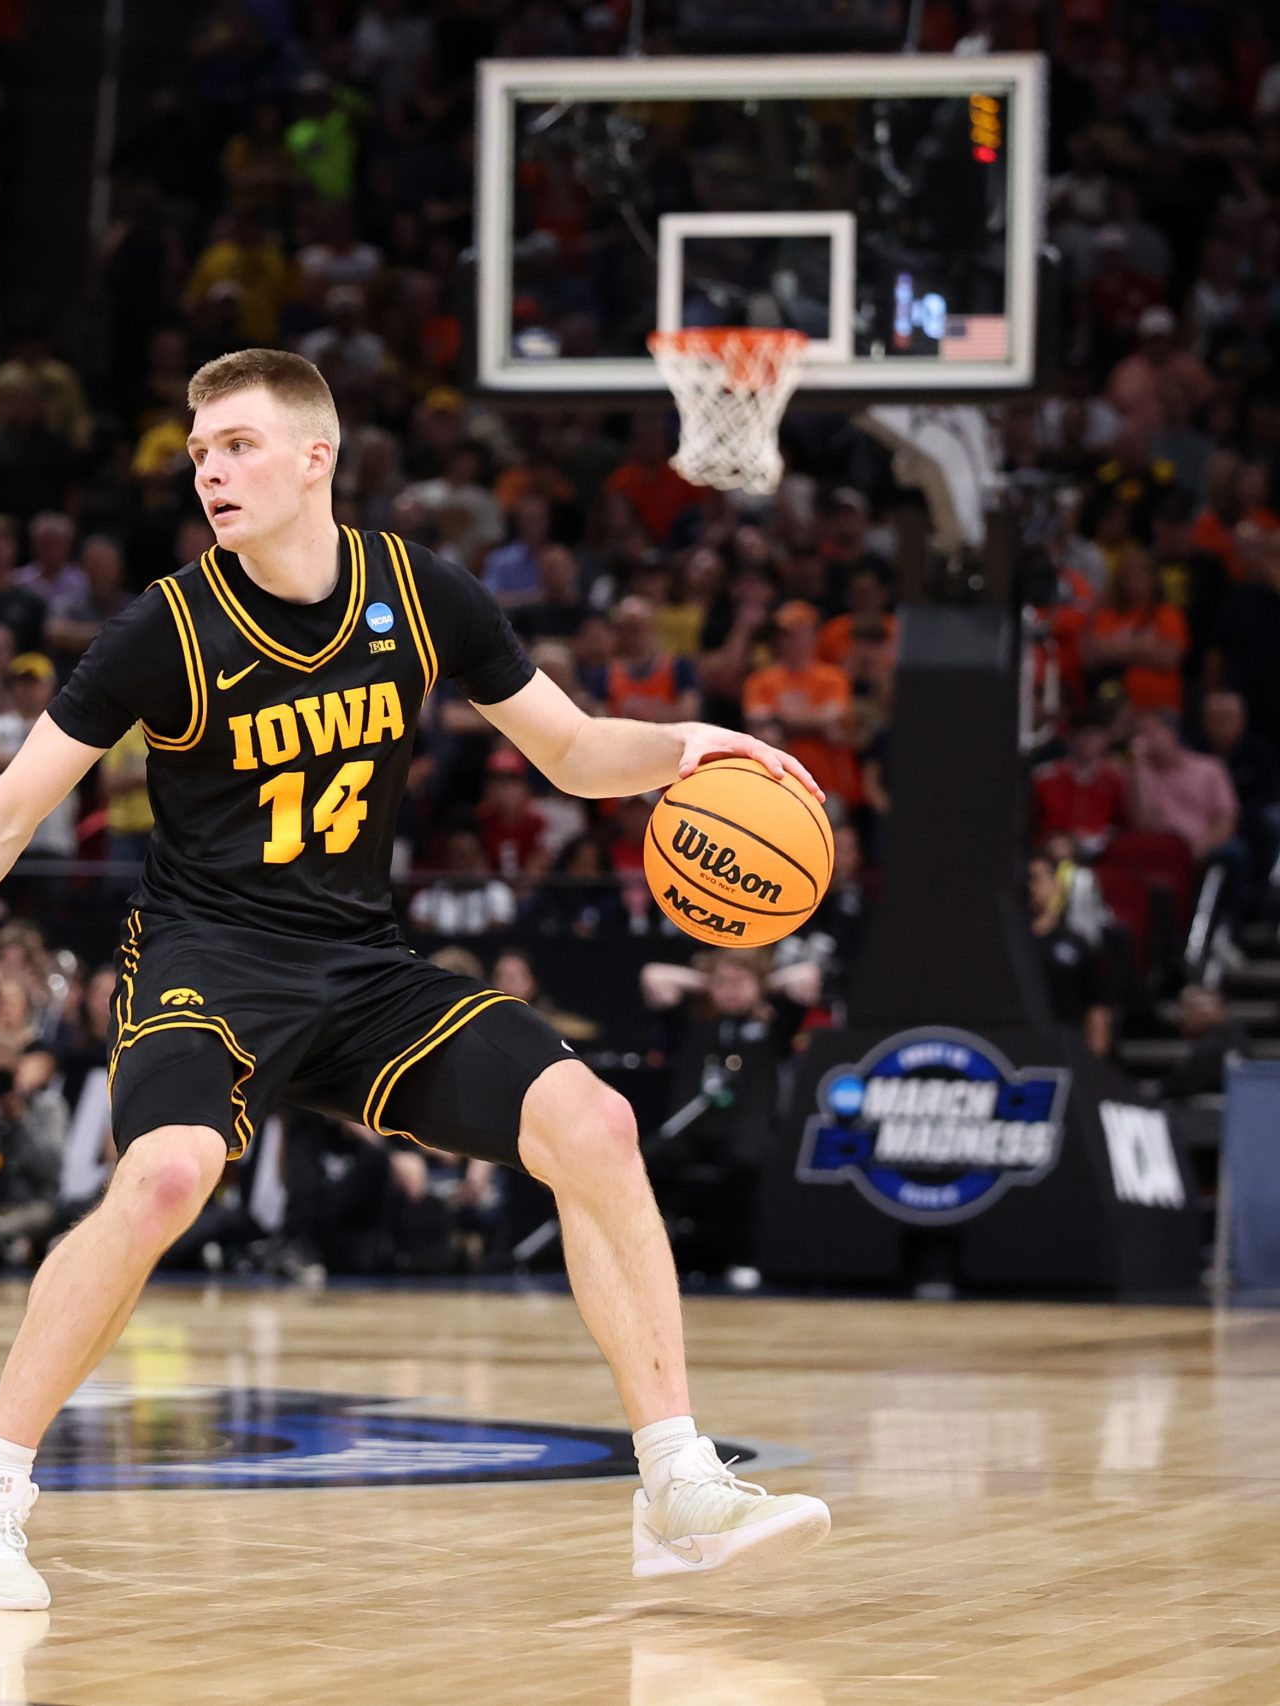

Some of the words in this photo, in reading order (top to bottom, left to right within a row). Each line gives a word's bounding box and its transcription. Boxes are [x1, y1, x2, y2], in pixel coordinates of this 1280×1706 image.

[370, 614, 393, 627] NCAA
[228, 681, 405, 770] IOWA
[259, 760, 374, 864] 14
[672, 818, 783, 904] Wilson
[699, 872, 717, 885] EVO
[718, 882, 737, 894] NXT
[663, 884, 746, 936] NCAA
[862, 1076, 998, 1121] MARCH
[874, 1120, 1056, 1165] MADNESS
